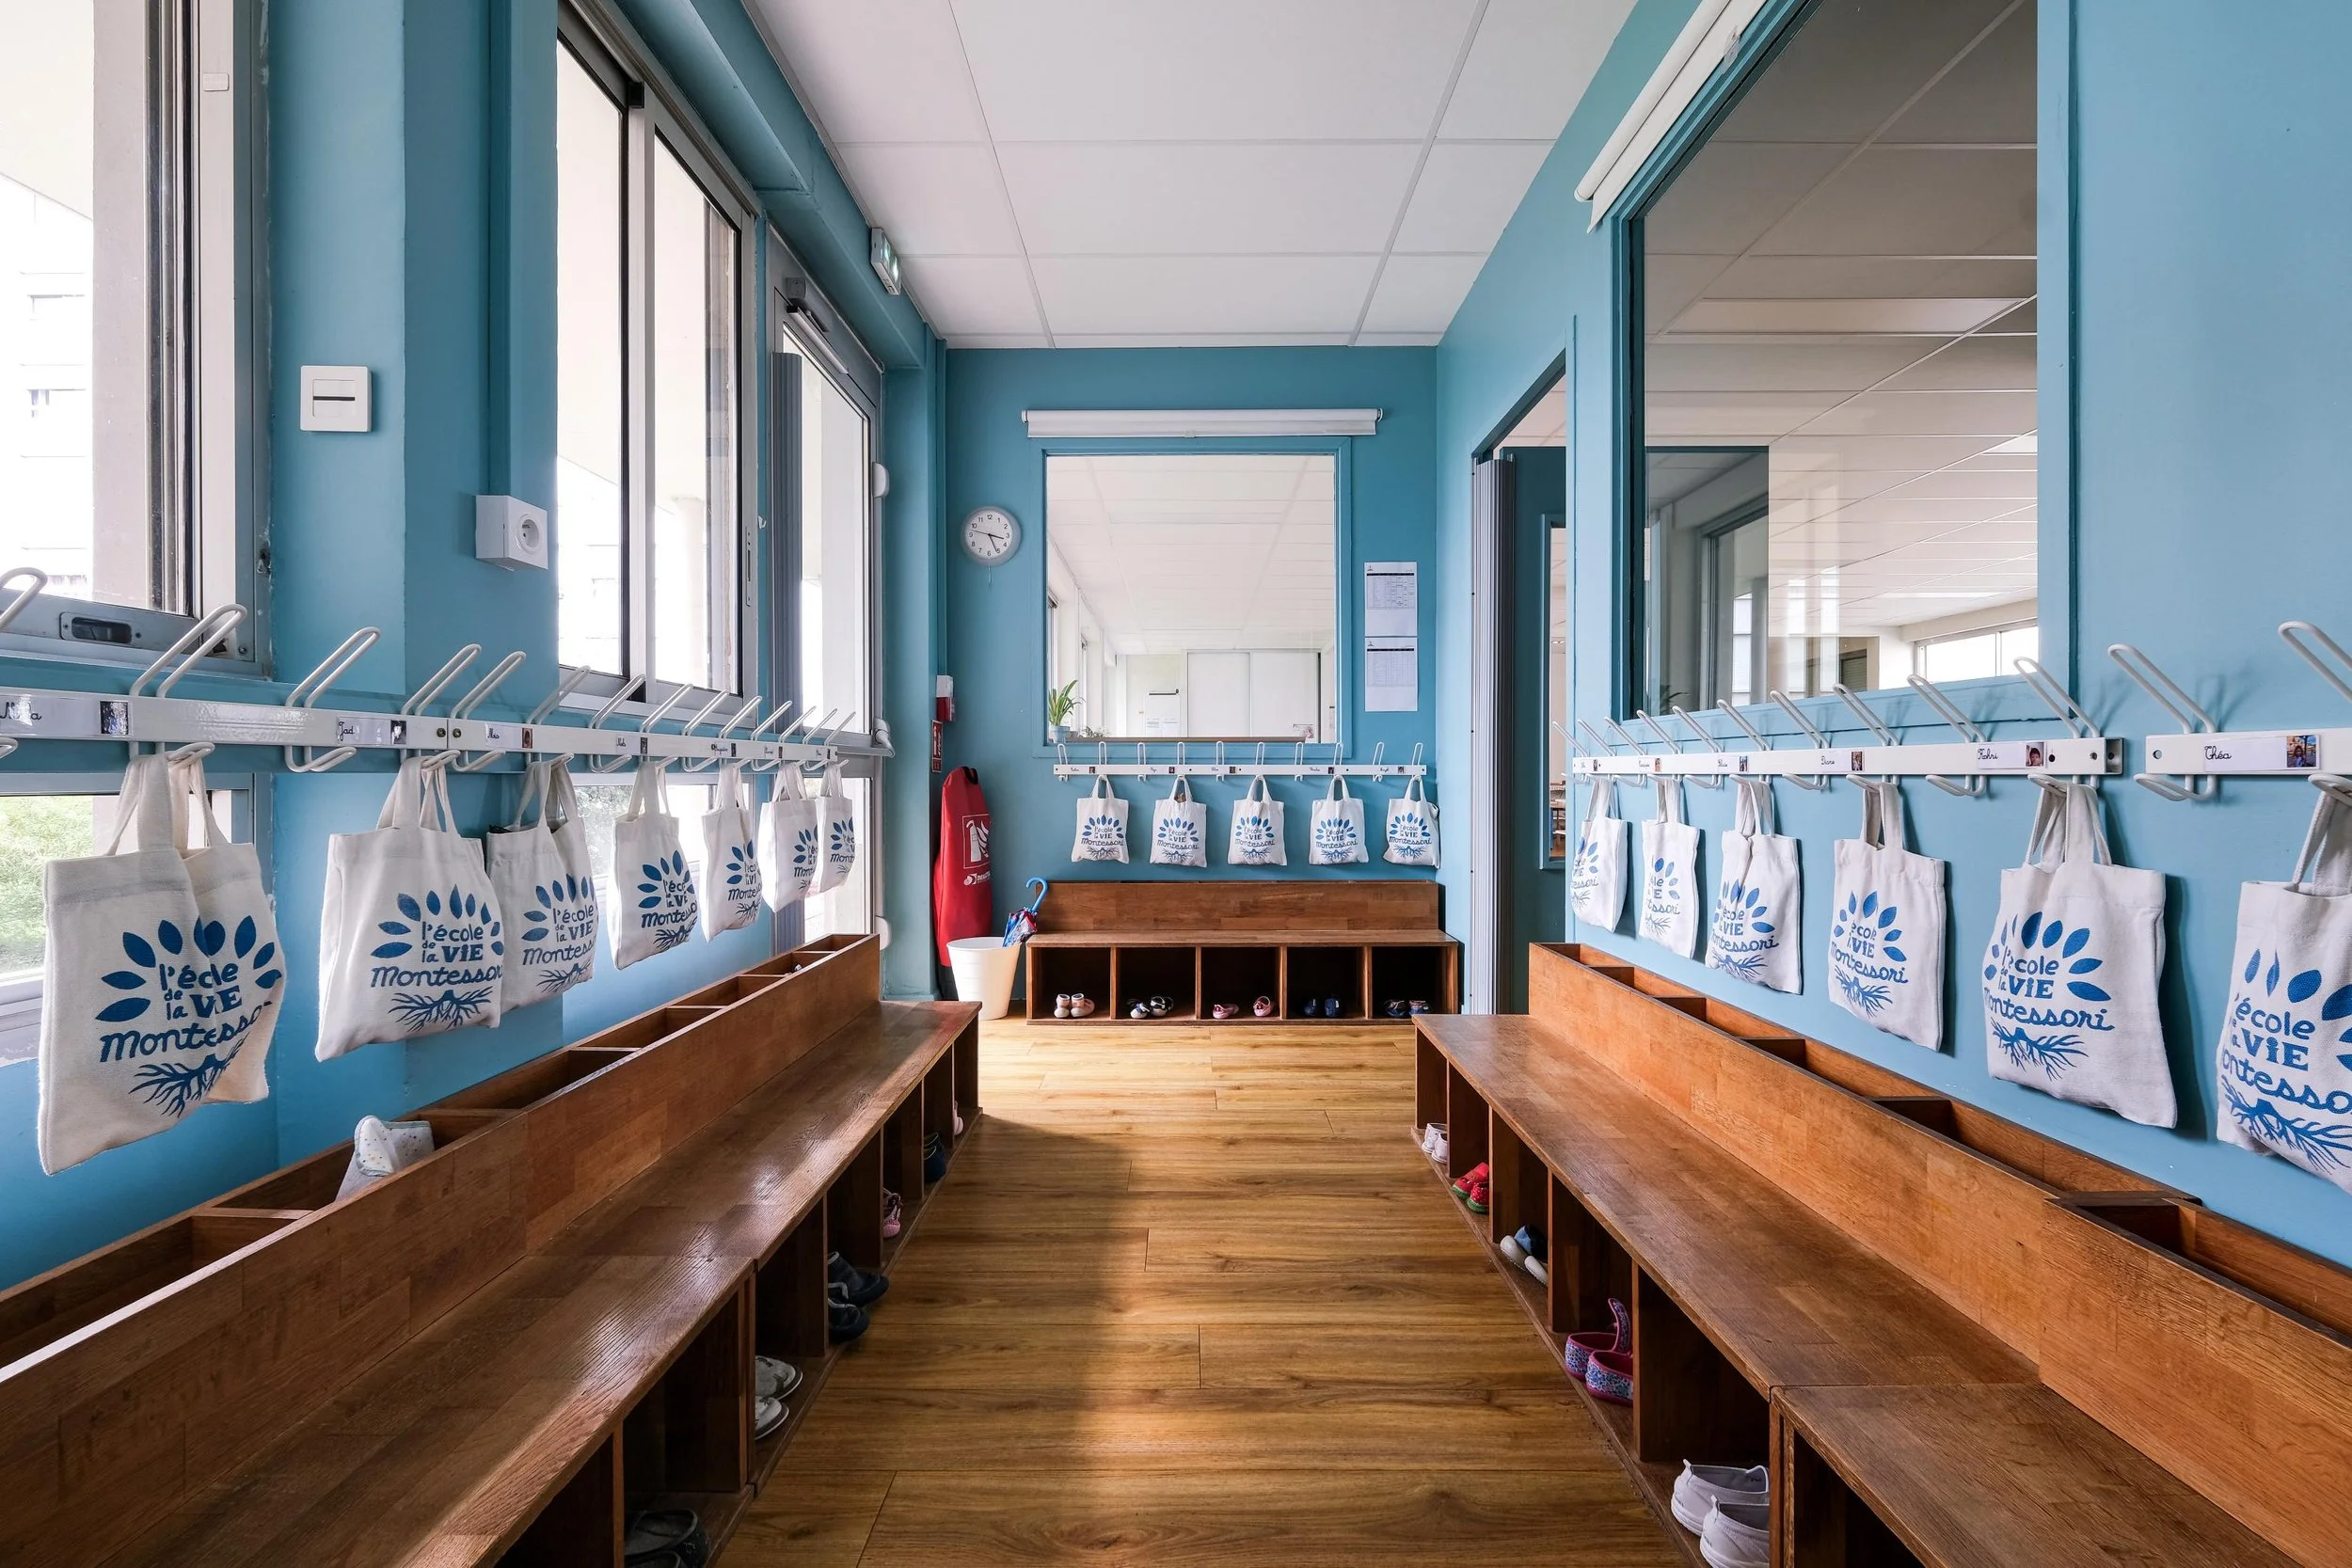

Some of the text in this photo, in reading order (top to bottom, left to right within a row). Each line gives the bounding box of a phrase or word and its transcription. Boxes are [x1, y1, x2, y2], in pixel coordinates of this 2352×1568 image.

[552, 904, 595, 925] l'école
[421, 921, 485, 942] l'école
[554, 923, 565, 932] de
[555, 931, 568, 943] la
[421, 941, 437, 950] de
[421, 950, 439, 963] la
[164, 988, 183, 1001] de
[166, 1002, 188, 1021] la
